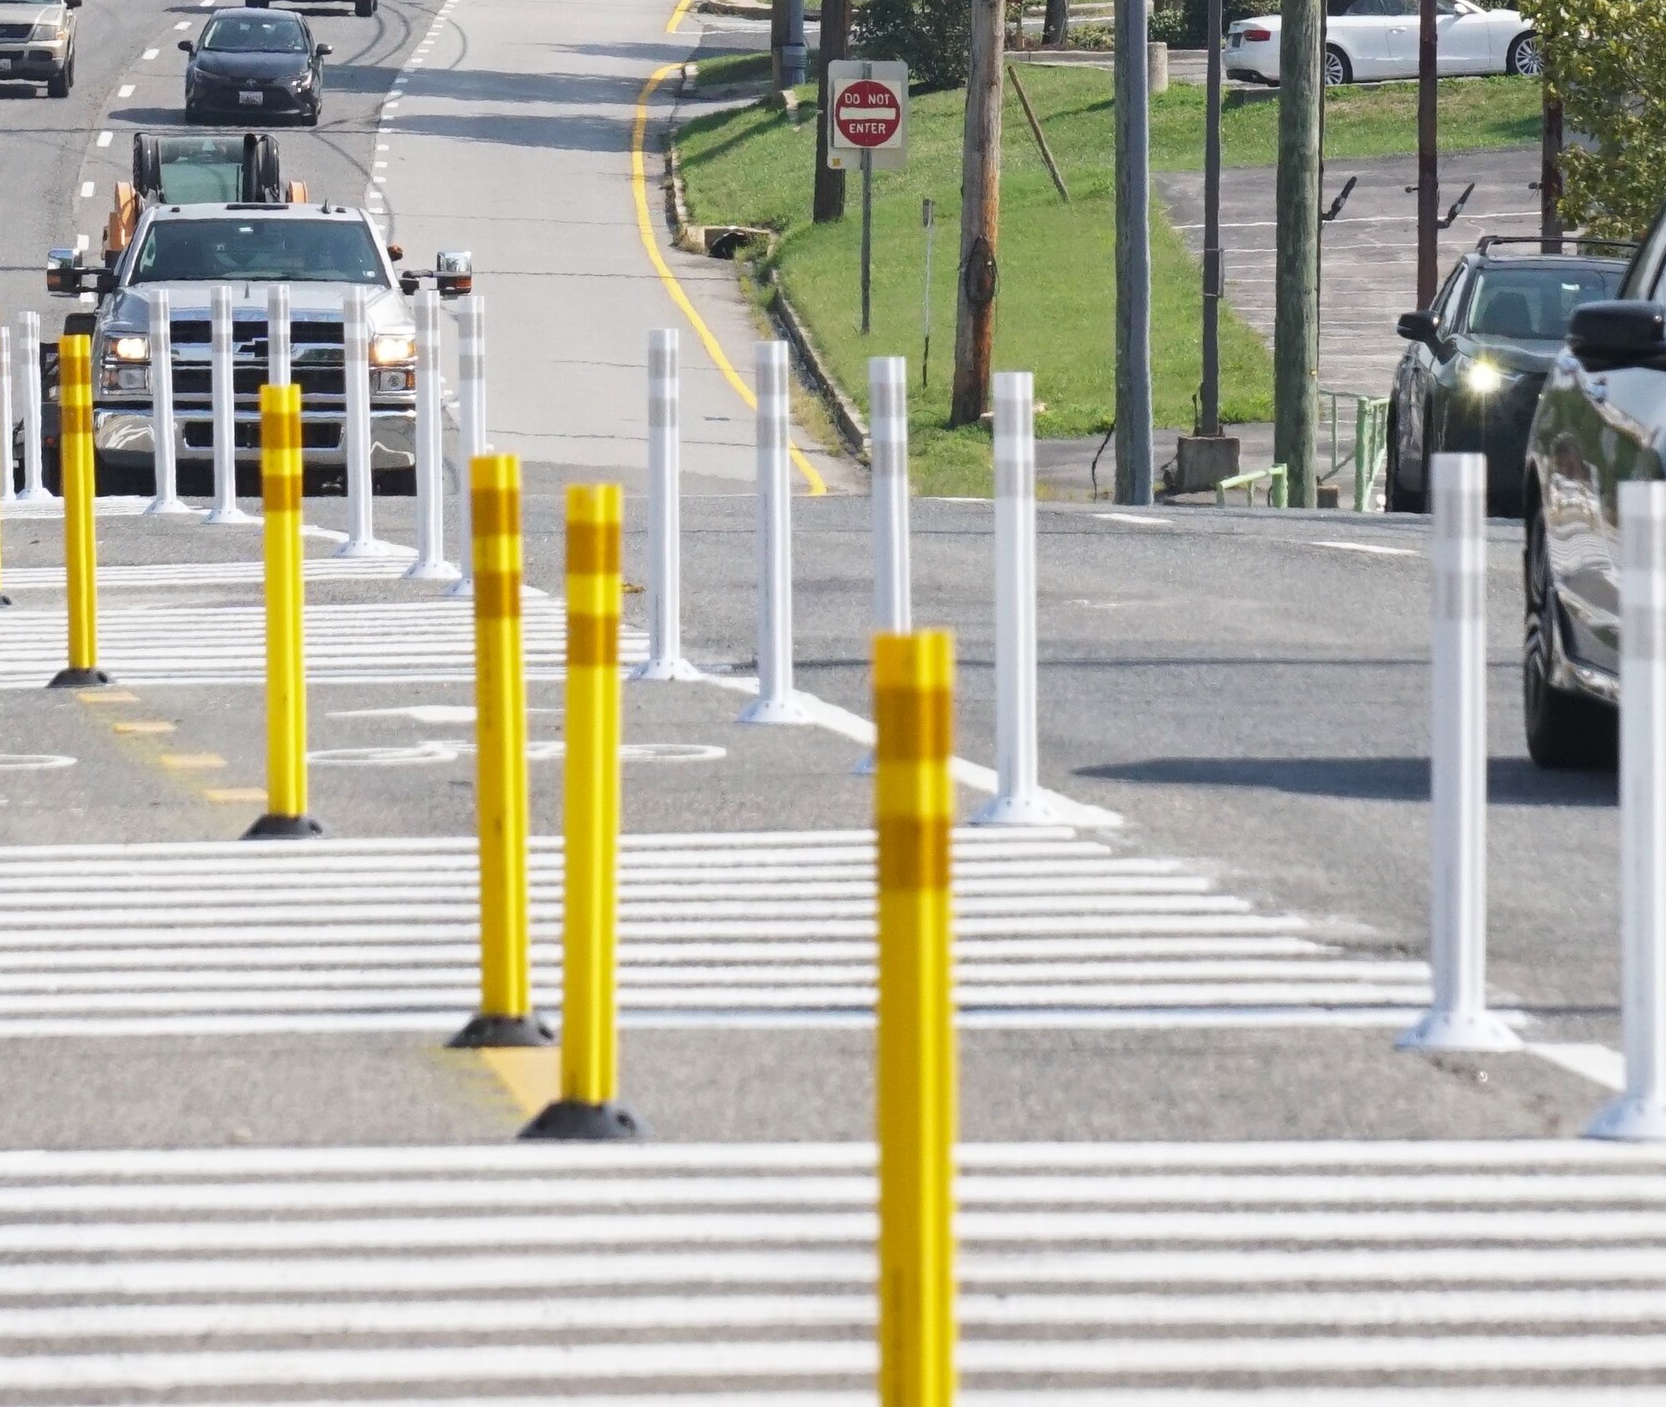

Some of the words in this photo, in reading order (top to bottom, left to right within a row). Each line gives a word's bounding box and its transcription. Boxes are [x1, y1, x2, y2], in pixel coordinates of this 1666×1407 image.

[844, 93, 861, 105] DO
[868, 93, 890, 105] NOT
[849, 122, 886, 135] ENTER
